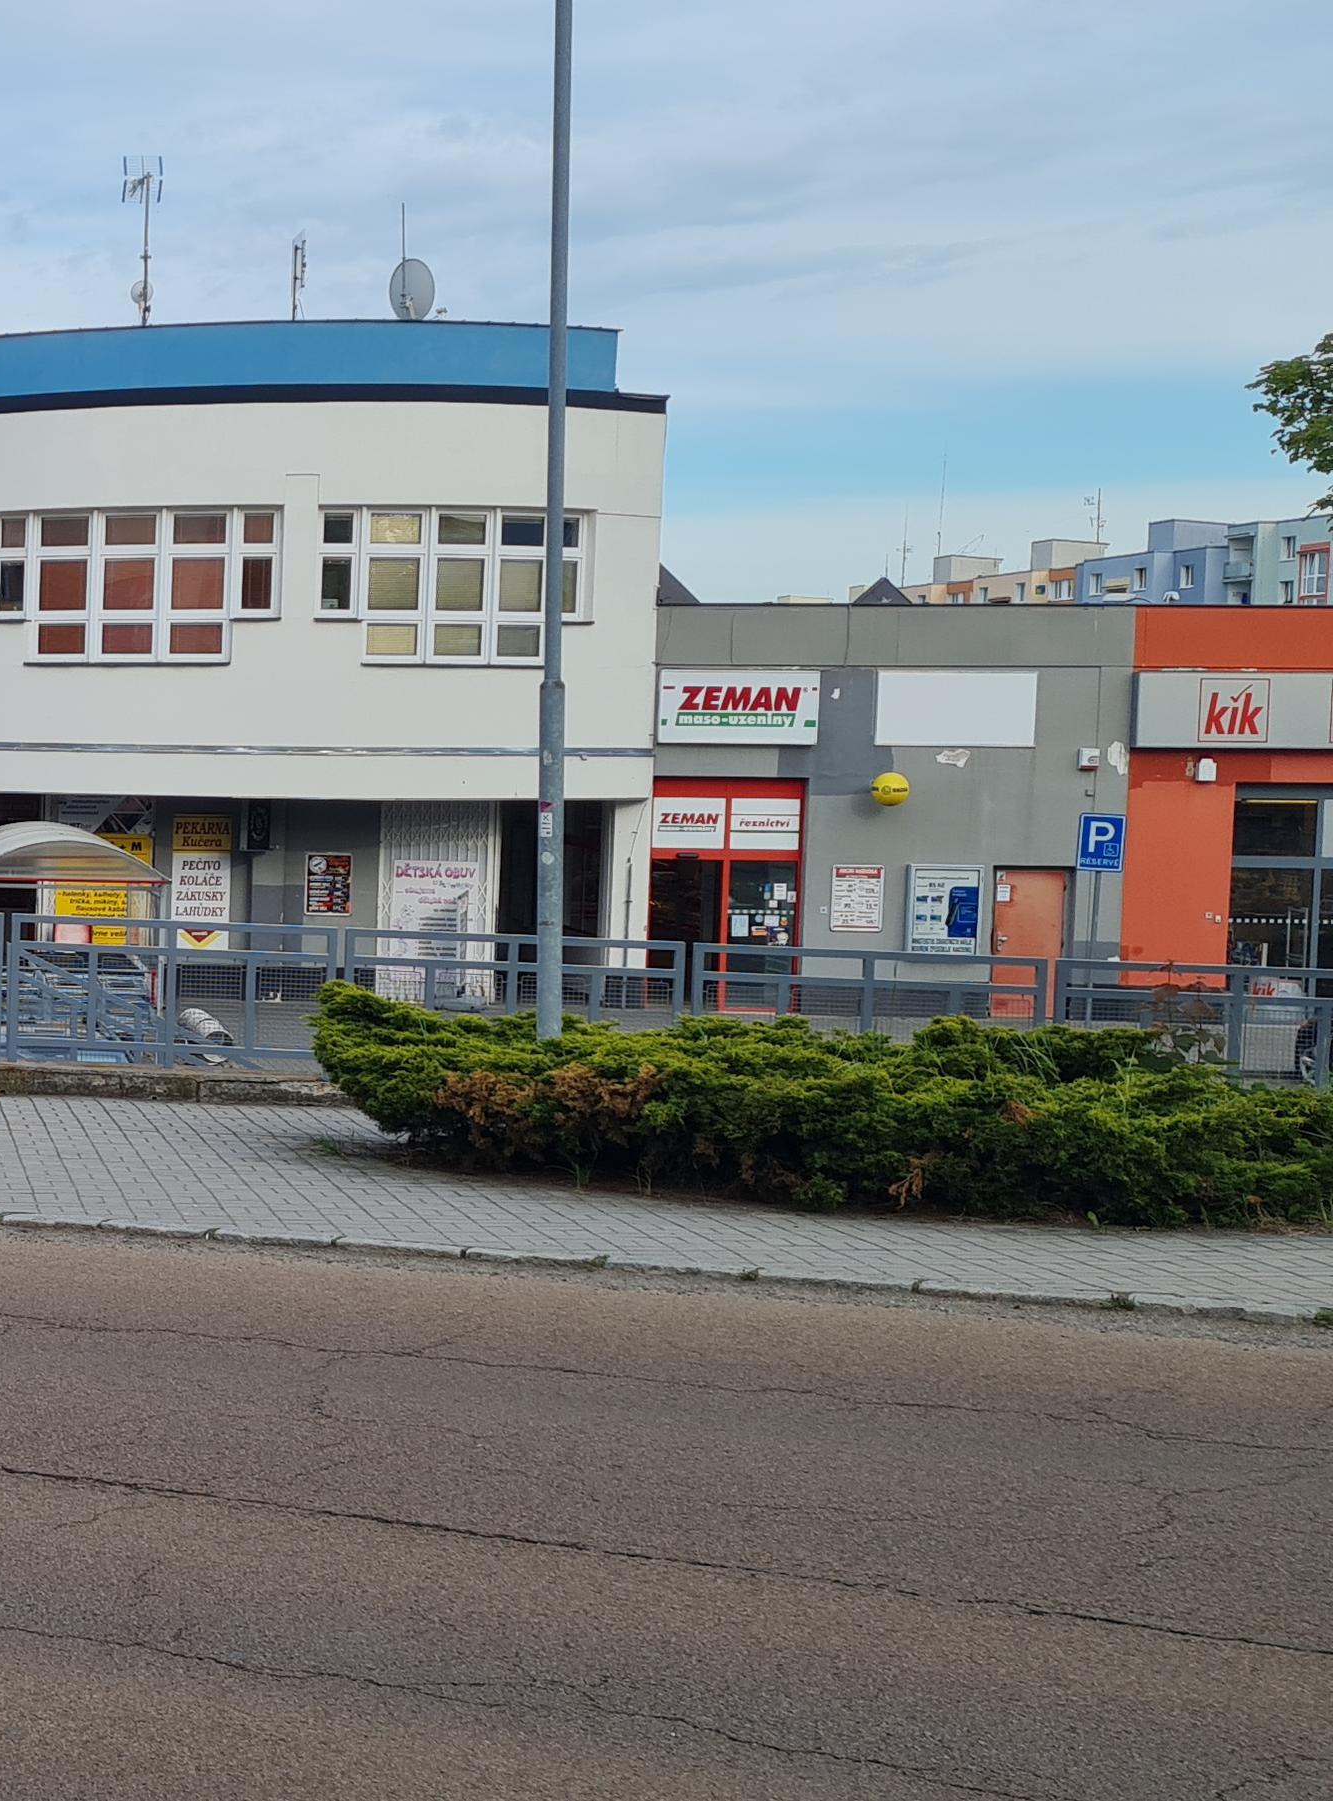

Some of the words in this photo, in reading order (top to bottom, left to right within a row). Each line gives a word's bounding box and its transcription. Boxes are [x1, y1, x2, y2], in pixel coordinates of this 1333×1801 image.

[678, 713, 793, 727] maso-uzeniny
[659, 813, 719, 824] ZEMAN
[739, 818, 790, 827] řeznictví
[175, 819, 230, 835] PEKÁRNA
[182, 836, 222, 847] Kučera
[1088, 821, 1115, 852] P
[181, 858, 221, 870] PEČIVO
[395, 863, 443, 878] DĚTSKÁ
[445, 867, 476, 879] OBUV
[179, 873, 222, 886] KOLÁČE
[175, 888, 226, 901] ZÁKUSKY
[175, 902, 226, 917] LAHŮDKY
